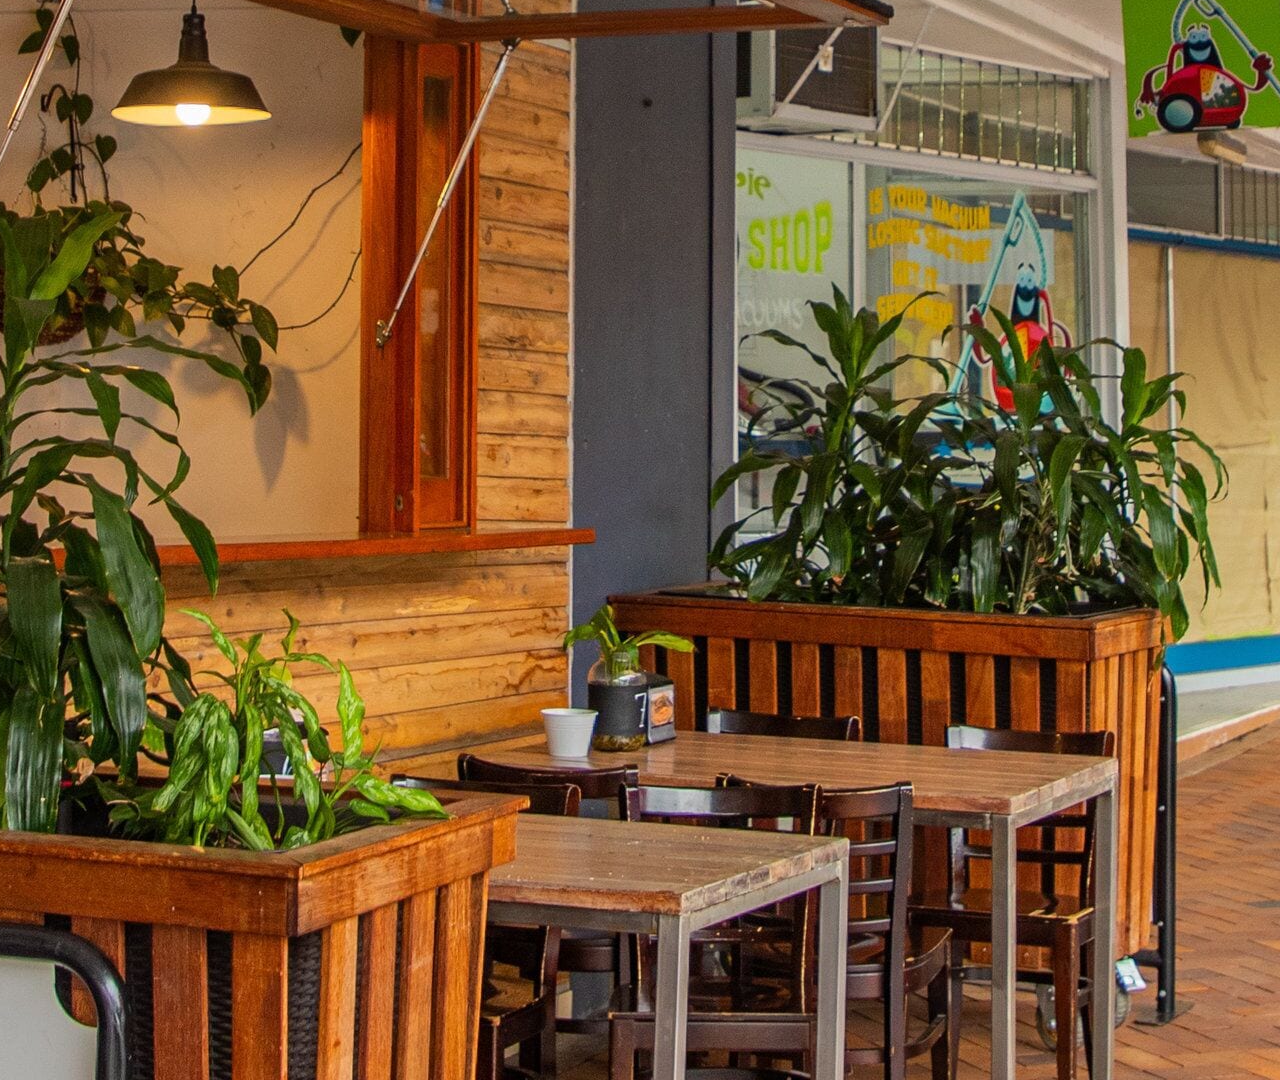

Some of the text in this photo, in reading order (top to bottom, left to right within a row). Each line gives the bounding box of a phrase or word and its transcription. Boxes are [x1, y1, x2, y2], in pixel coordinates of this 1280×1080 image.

[868, 183, 991, 232] IS YOUR VACUUM
[747, 200, 833, 275] SHOP
[868, 217, 920, 249] LOSING
[892, 260, 920, 287] GET
